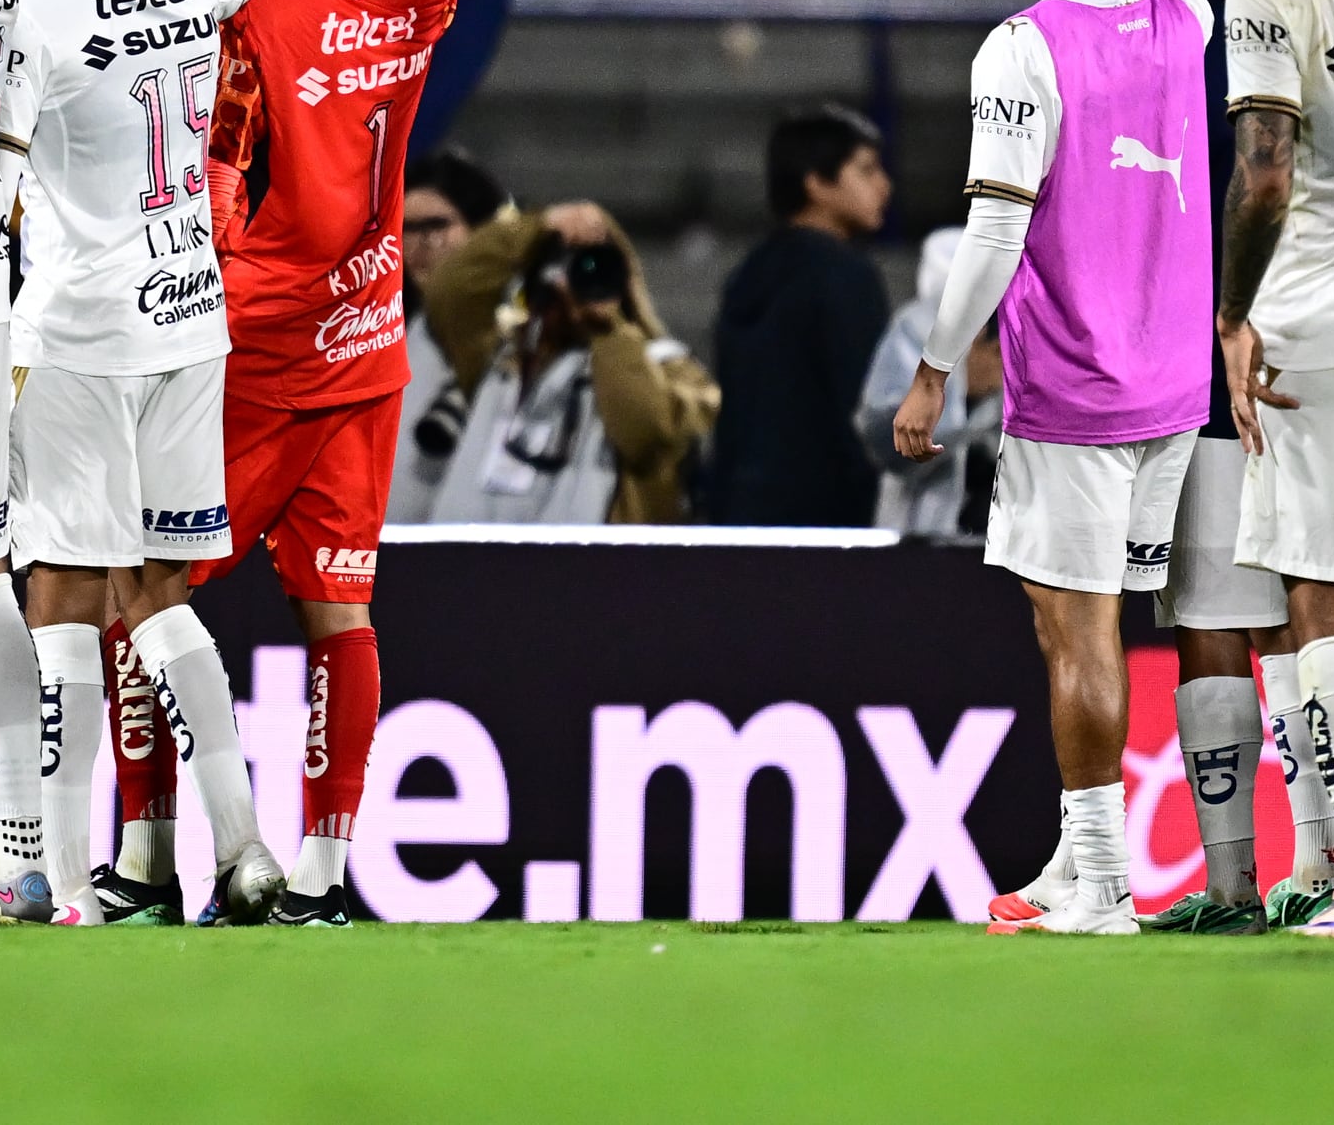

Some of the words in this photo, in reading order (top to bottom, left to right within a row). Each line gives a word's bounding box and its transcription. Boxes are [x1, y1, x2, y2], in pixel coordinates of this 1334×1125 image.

[123, 9, 218, 56] SUZU
[320, 7, 418, 55] telcel
[1118, 17, 1151, 34] PUMAS
[1229, 18, 1288, 44] GNP
[979, 95, 1036, 126] GNP
[129, 52, 216, 217] 15
[364, 99, 395, 234] 1
[153, 290, 225, 326] caliente.m
[326, 322, 404, 363] caliente.m
